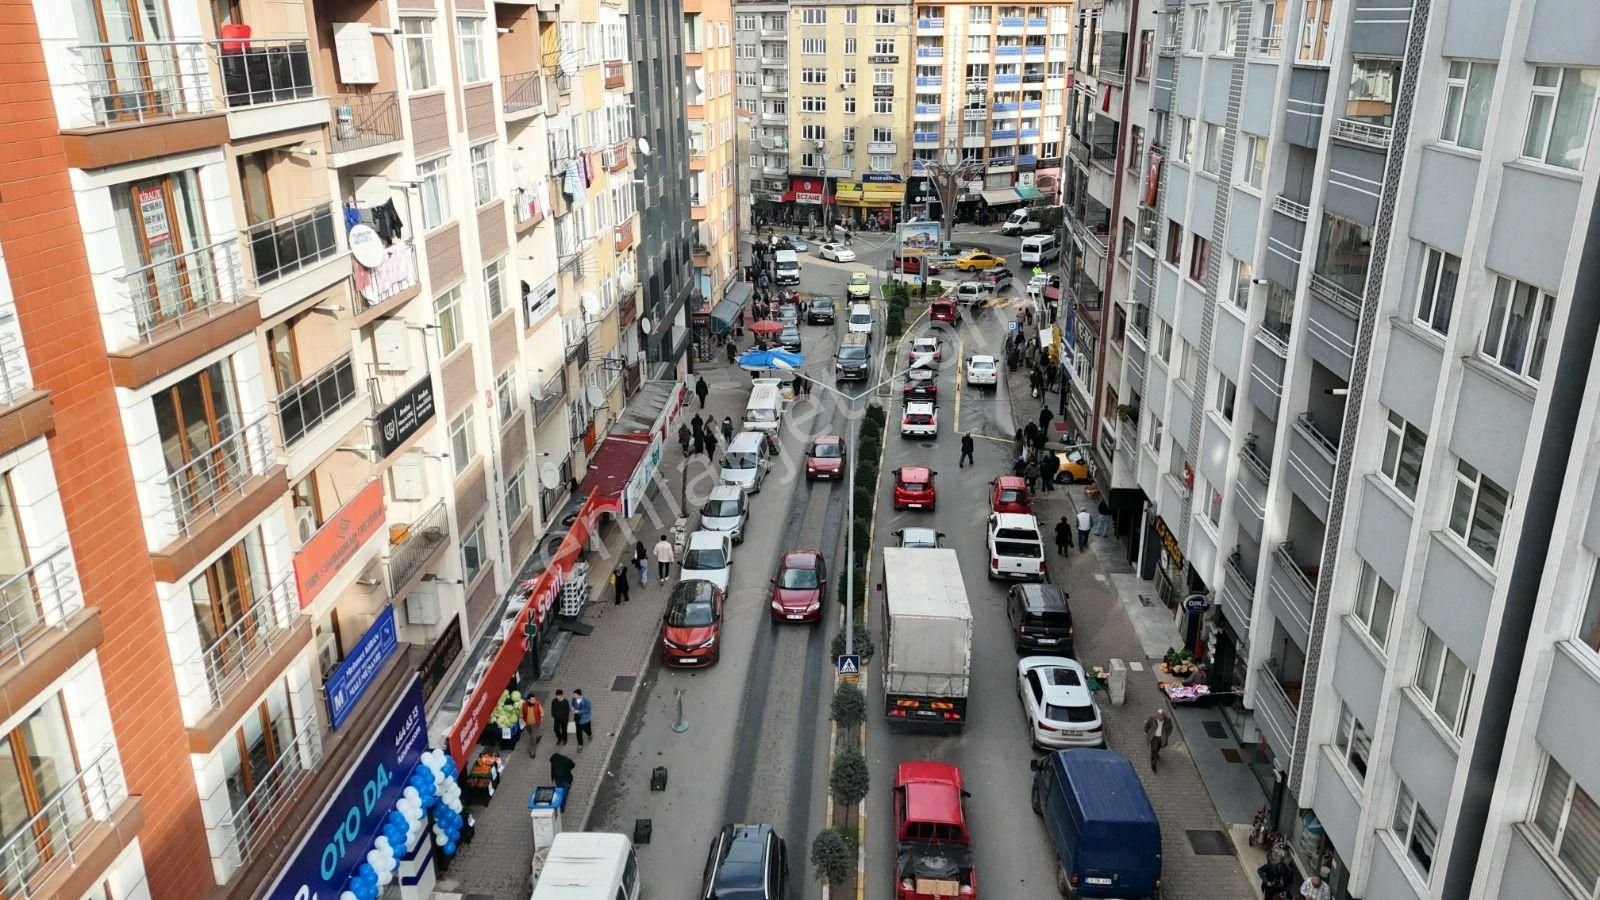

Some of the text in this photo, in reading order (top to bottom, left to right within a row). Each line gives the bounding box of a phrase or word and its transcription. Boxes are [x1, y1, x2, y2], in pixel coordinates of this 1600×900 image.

[797, 193, 821, 202] ECZANE
[333, 691, 344, 711] M
[320, 805, 361, 881] OTO
